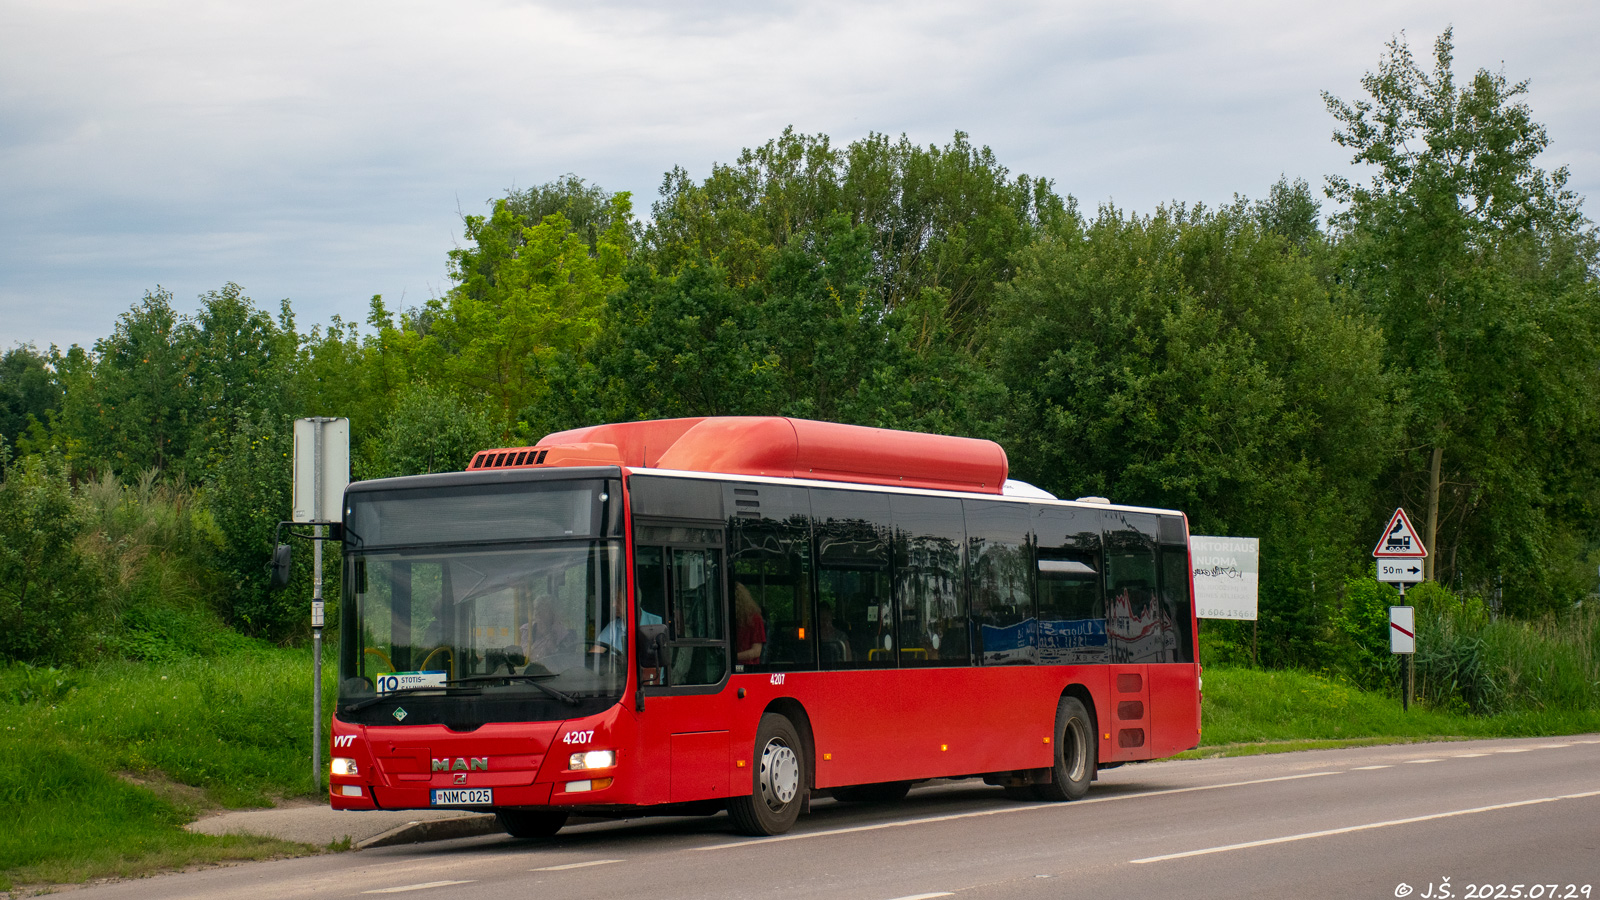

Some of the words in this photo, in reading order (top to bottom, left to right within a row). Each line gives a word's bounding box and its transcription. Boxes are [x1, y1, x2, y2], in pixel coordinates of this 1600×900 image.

[1191, 542, 1256, 553] AKTORIAUS
[1196, 556, 1237, 566] NUOMA
[1383, 566, 1394, 574] 50
[1200, 608, 1205, 616] 8
[378, 676, 399, 694] 10
[770, 673, 785, 685] 4207
[563, 730, 594, 745] 4207
[432, 757, 488, 771] MAN
[443, 791, 467, 803] NMC
[469, 790, 490, 802] 025
